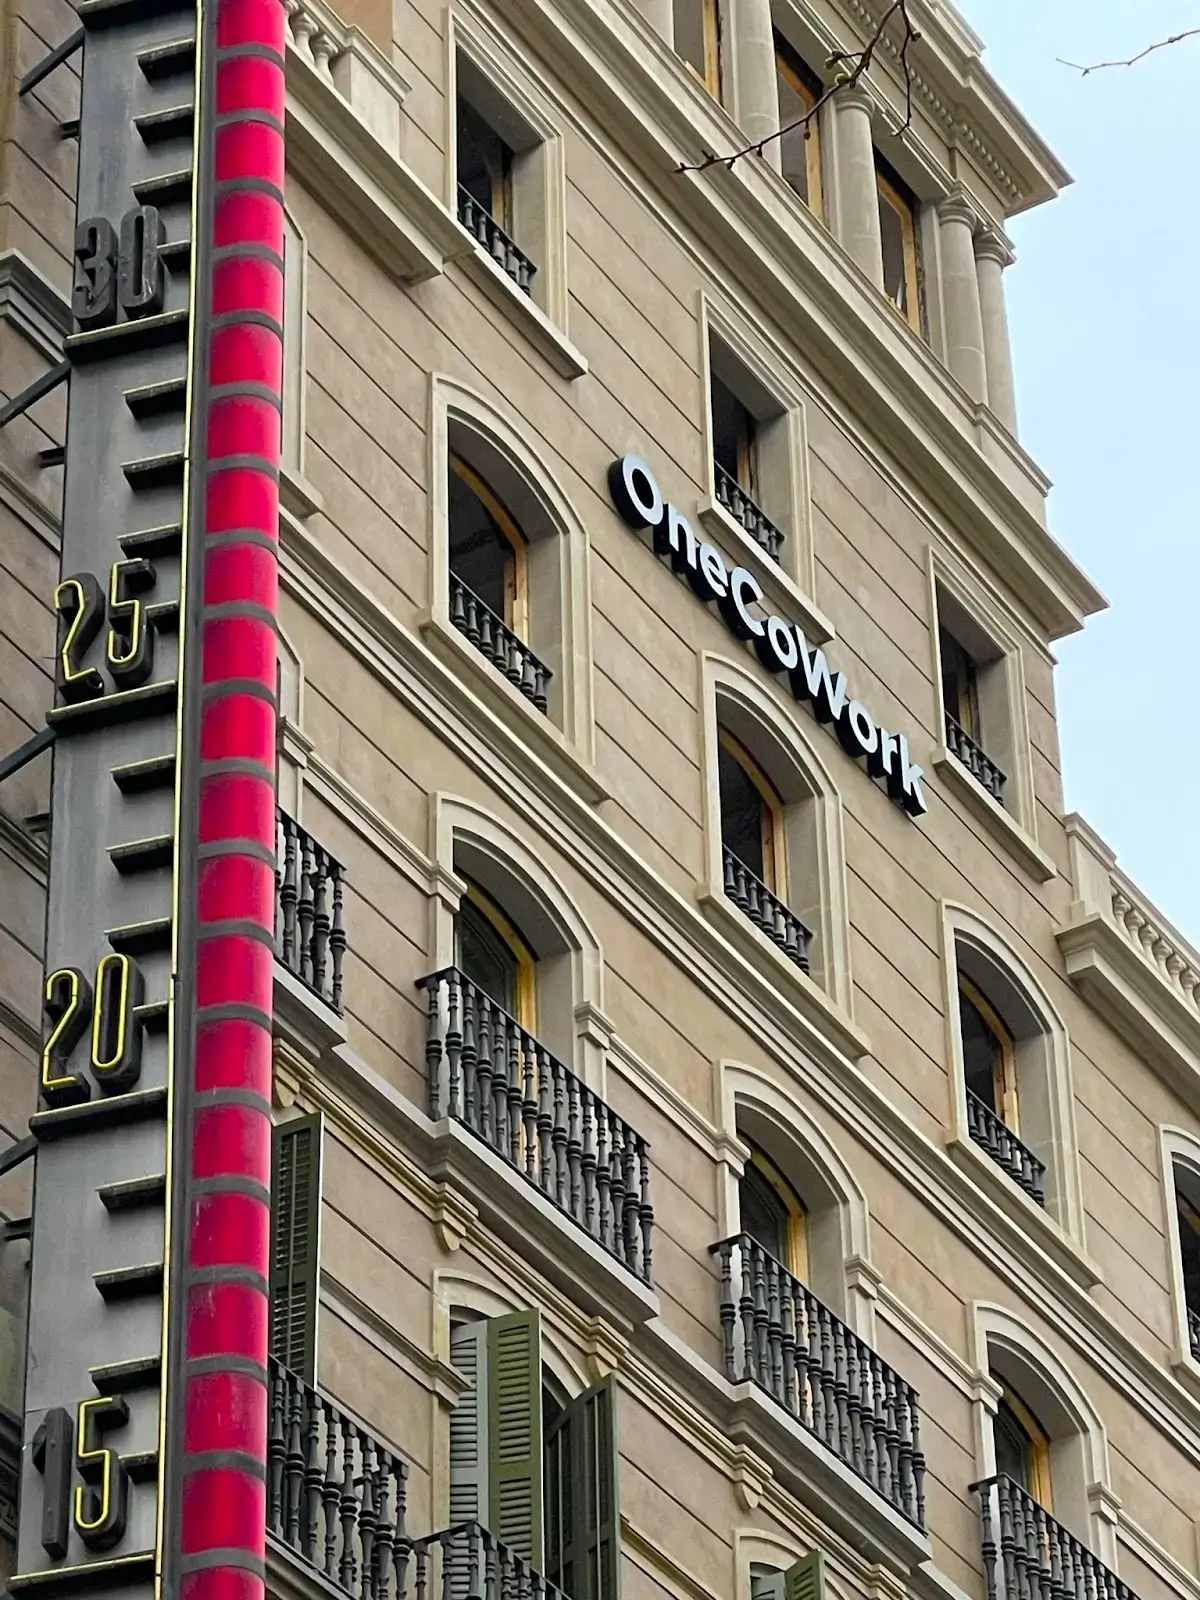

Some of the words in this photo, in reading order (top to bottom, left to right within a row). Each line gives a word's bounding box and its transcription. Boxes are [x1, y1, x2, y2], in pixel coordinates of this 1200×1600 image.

[72, 205, 166, 333] 30
[54, 557, 157, 704] 25
[42, 953, 145, 1107] 20
[32, 1394, 129, 1560] 15
